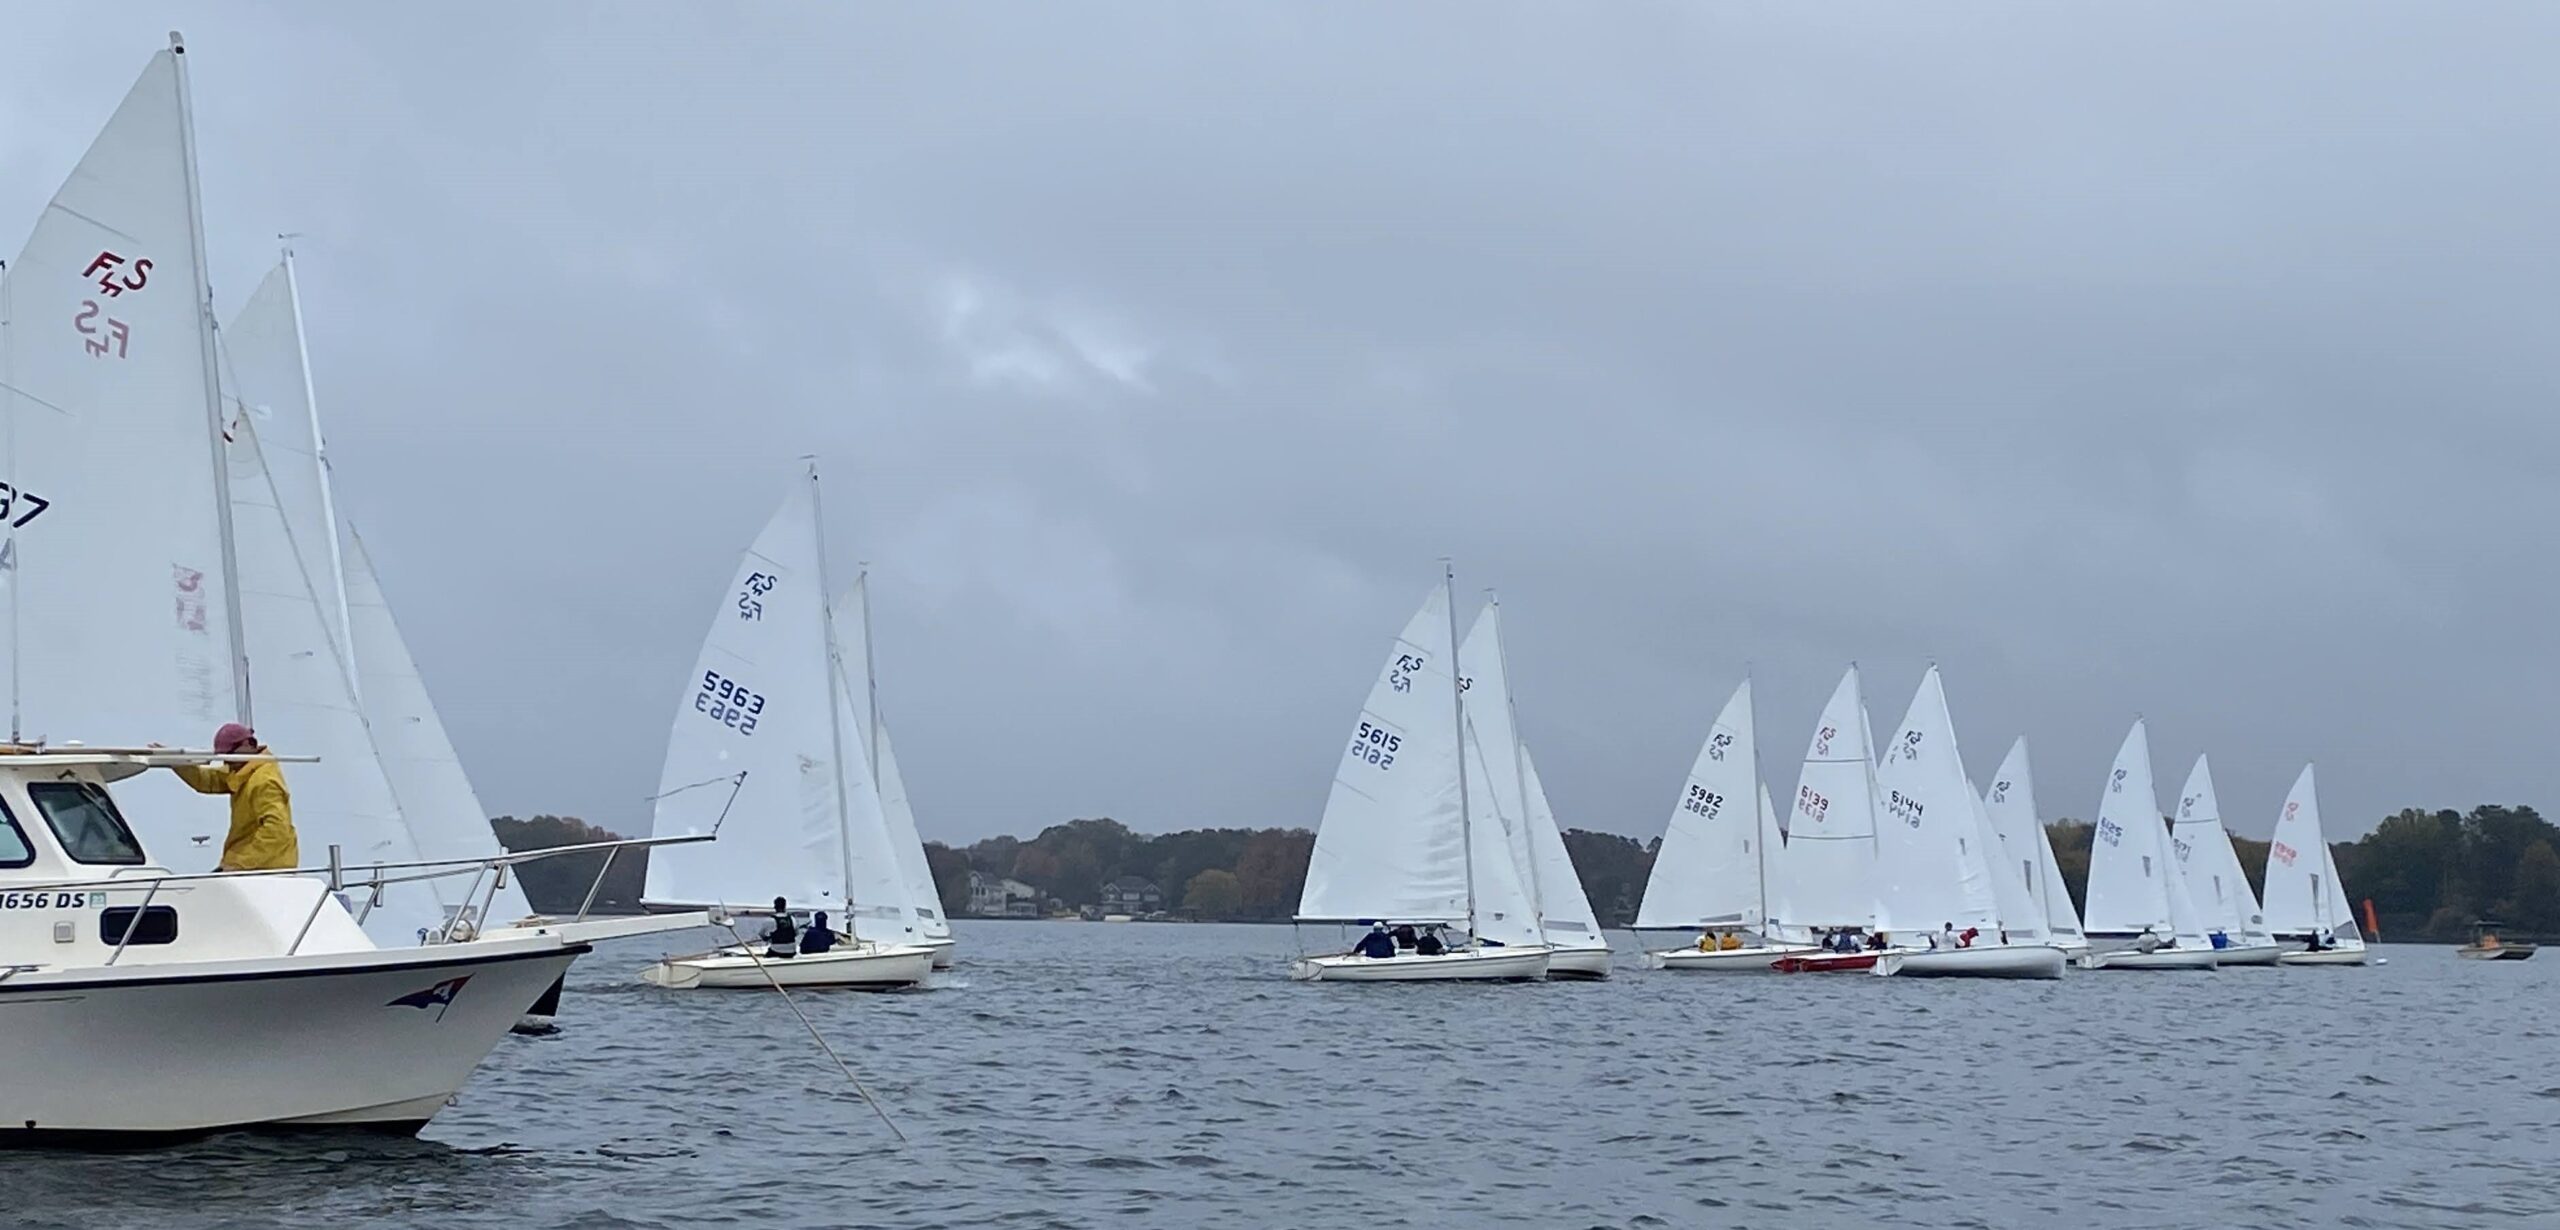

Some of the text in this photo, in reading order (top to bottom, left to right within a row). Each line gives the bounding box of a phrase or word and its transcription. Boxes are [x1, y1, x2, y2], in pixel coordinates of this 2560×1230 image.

[702, 670, 765, 714] 5963
[1358, 722, 1402, 752] 5615
[1690, 784, 1723, 808] 5982
[1801, 785, 1829, 811] 6139
[1891, 790, 1924, 816] 6144
[56, 893, 85, 908] DS
